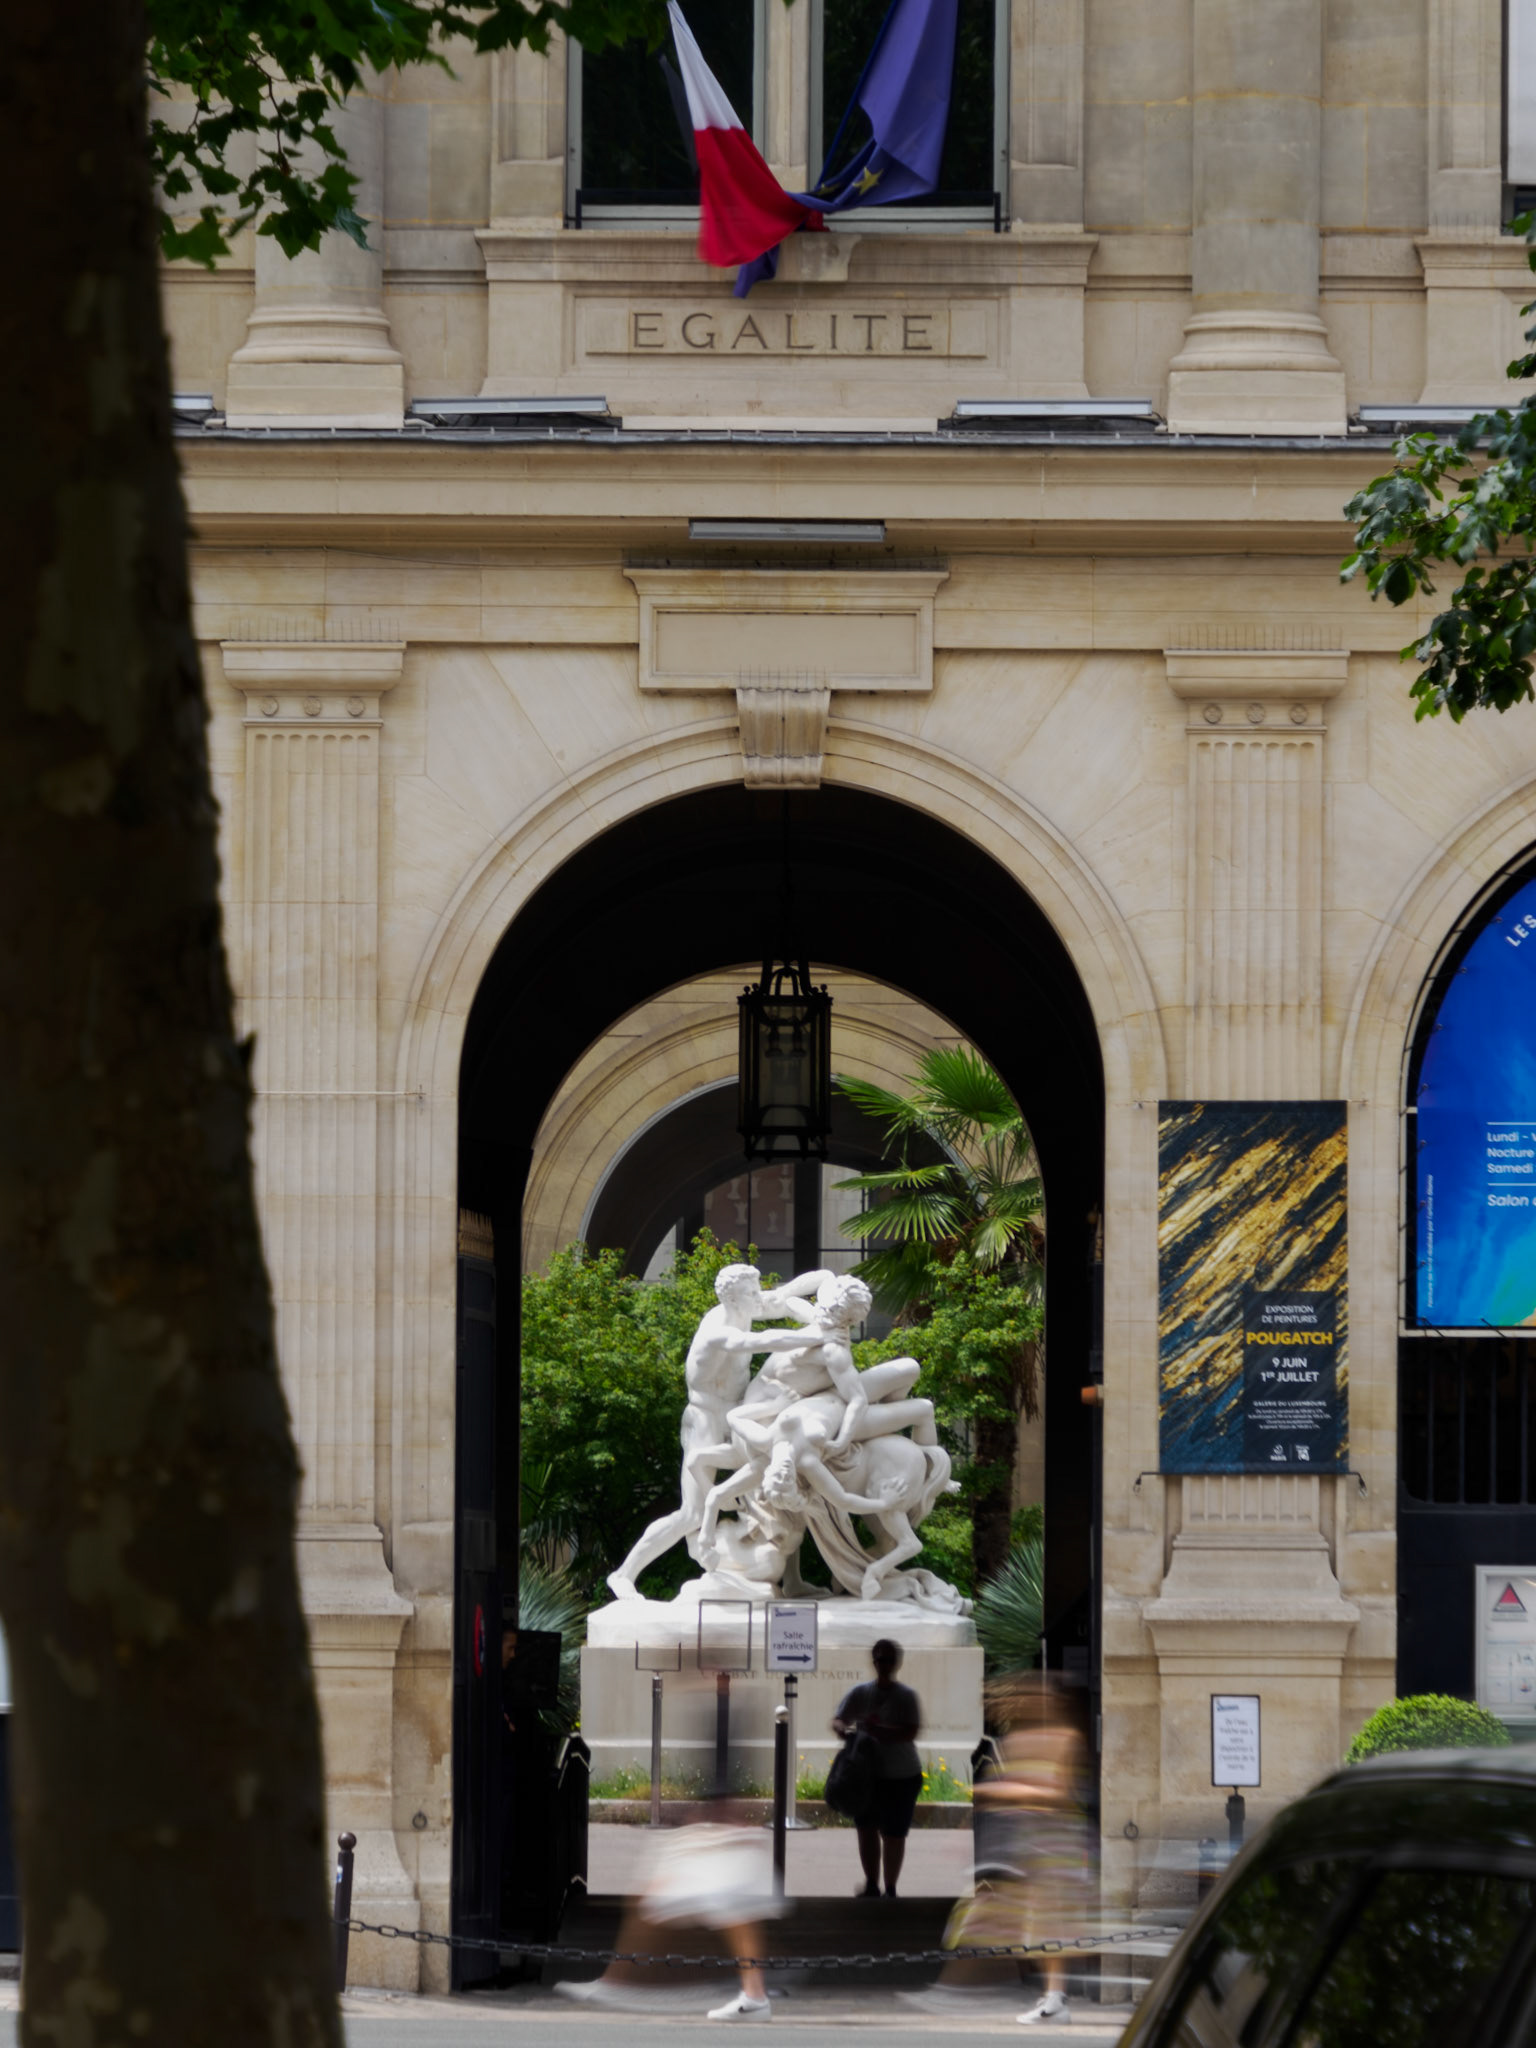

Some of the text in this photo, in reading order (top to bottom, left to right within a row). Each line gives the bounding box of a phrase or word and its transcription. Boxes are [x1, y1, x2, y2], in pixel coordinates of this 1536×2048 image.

[633, 312, 933, 351] EGALITE
[1506, 914, 1536, 947] LES
[1487, 1131, 1519, 1142] Lundi
[1487, 1162, 1534, 1173] Samedi
[1487, 1193, 1529, 1207] Salon
[1265, 1305, 1314, 1313] EXPOSITION
[1261, 1315, 1318, 1323] DE PEINTURES
[1246, 1331, 1333, 1345] POUGATCH
[1272, 1357, 1307, 1368] 9 JUIN
[1276, 1371, 1320, 1382] JUILLET
[784, 1630, 805, 1640] Salle
[773, 1641, 814, 1651] rafraîchie
